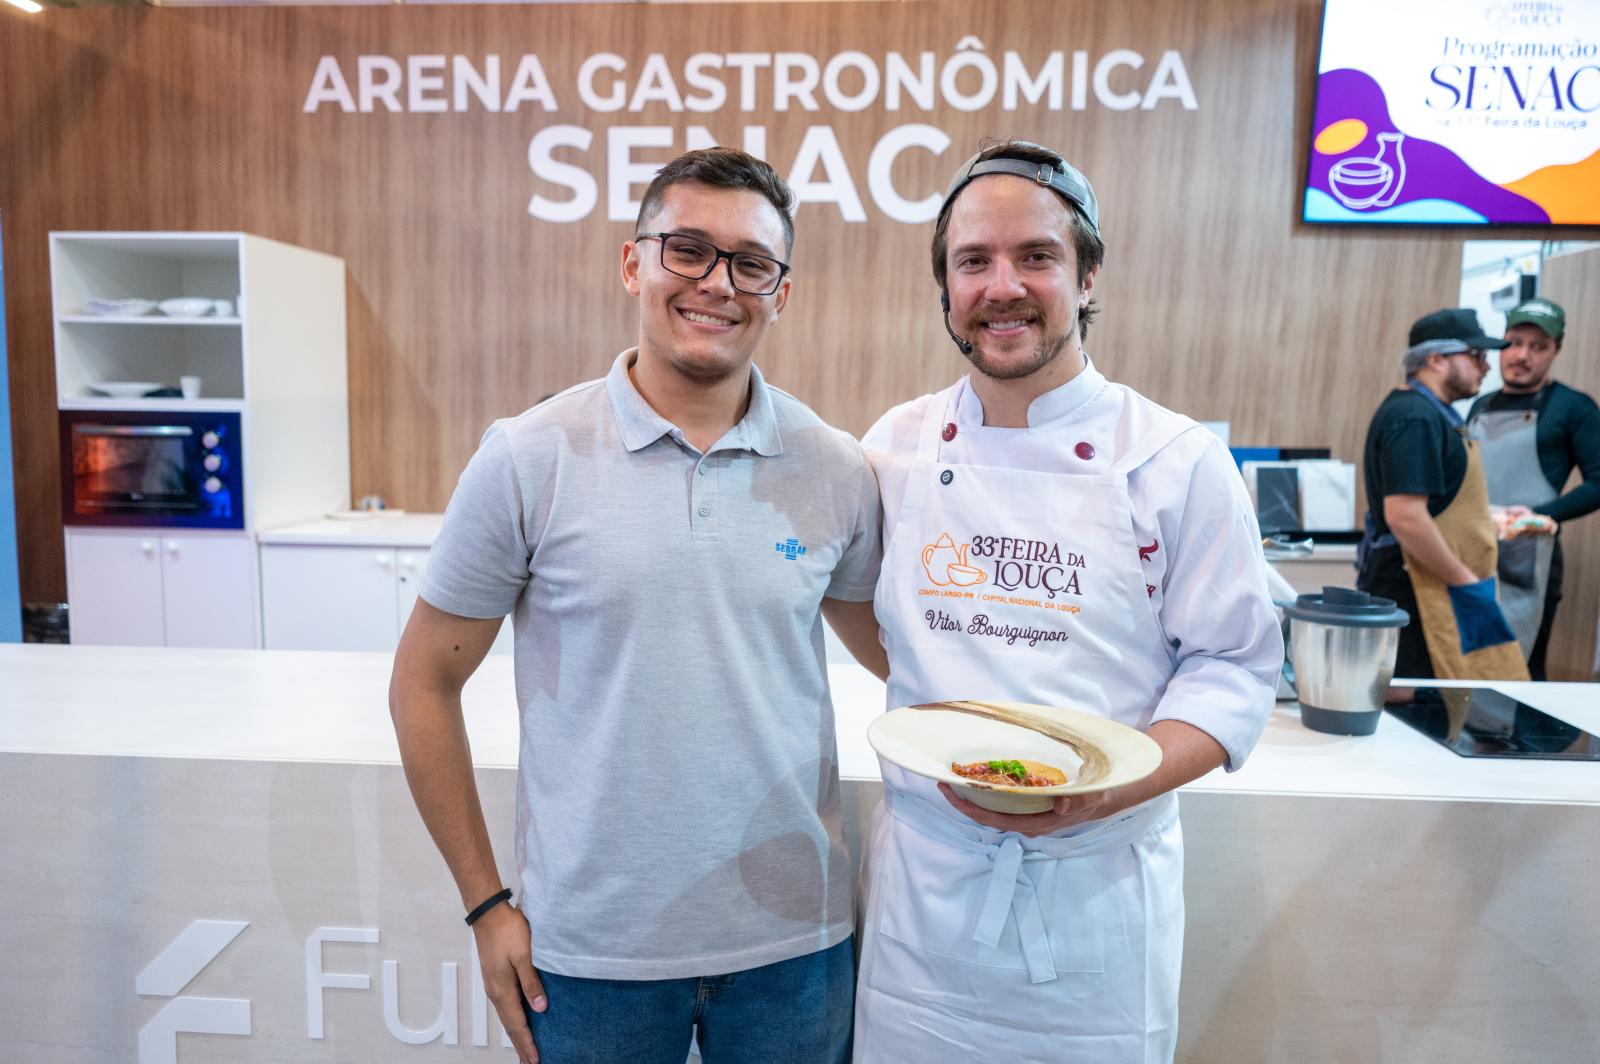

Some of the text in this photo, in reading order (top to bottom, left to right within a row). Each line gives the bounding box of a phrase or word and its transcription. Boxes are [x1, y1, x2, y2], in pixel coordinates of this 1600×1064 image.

[1443, 36, 1598, 60] Programação
[302, 35, 1199, 113] ARENA GASTRONÔMICA
[1425, 64, 1600, 113] SENAC
[993, 560, 1083, 599] LOUÇA
[1067, 552, 1087, 569] DA
[918, 588, 939, 597] CAMPO
[1008, 596, 1042, 608] NACIONAL
[925, 609, 1069, 647] Vitor Bourguignon
